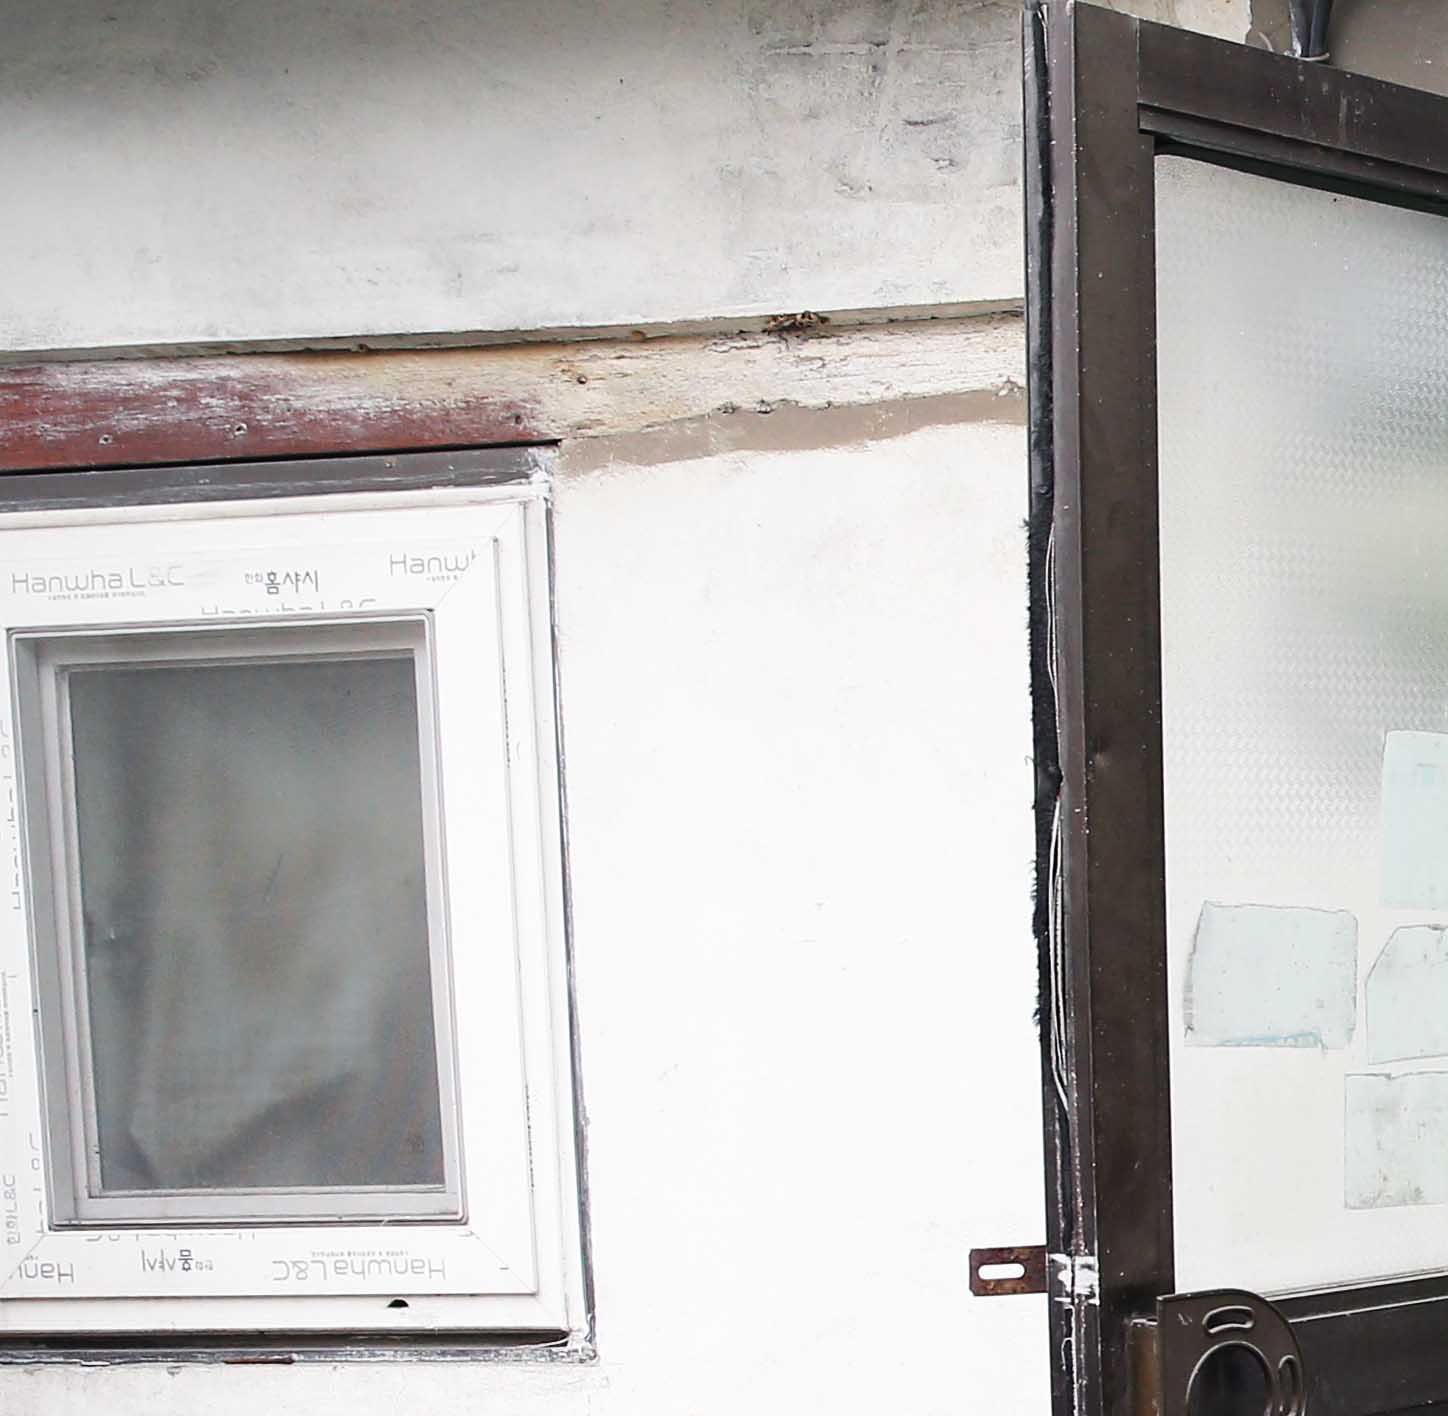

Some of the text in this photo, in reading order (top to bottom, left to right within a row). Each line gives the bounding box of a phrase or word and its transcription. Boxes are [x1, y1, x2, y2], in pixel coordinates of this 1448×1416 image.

[12, 565, 185, 594] Hanwha L&C
[271, 1258, 446, 1281] L&C Hanwha
